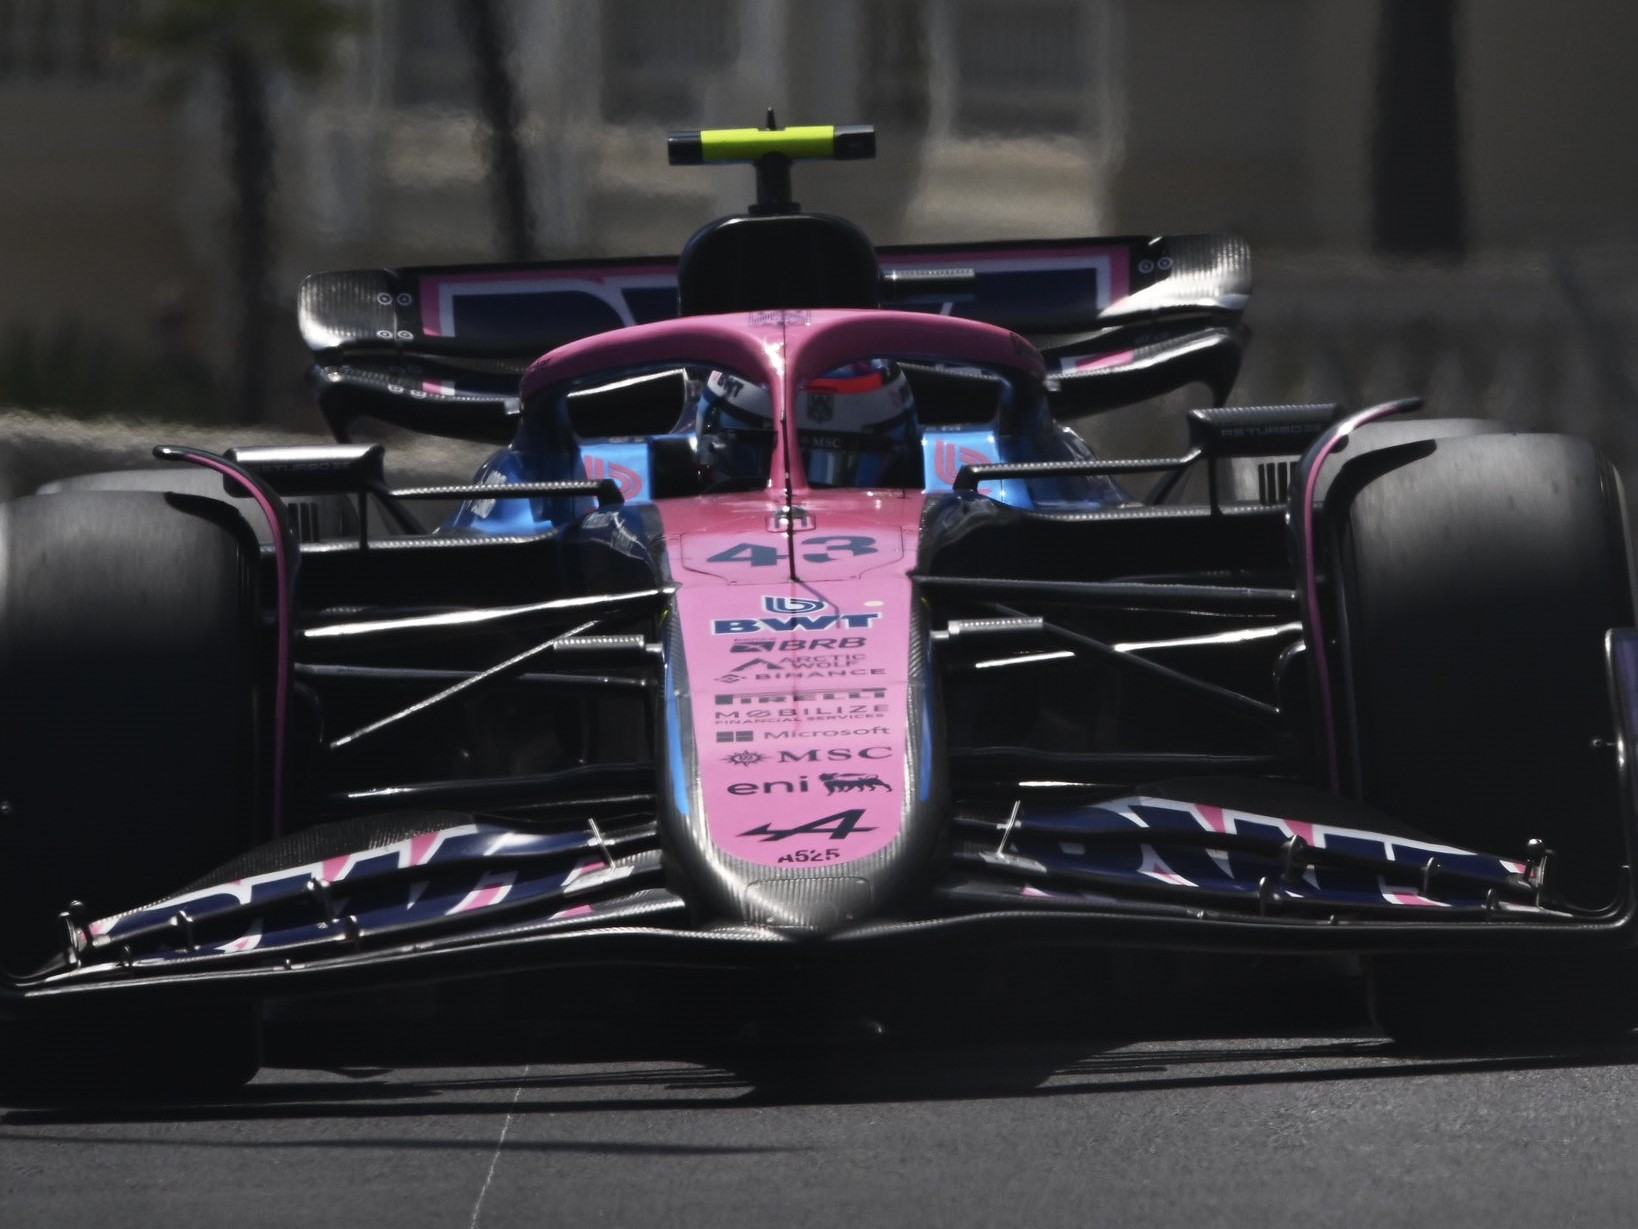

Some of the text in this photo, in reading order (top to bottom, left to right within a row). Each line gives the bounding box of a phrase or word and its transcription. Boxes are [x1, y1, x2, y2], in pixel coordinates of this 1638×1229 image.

[706, 535, 879, 567] 43
[712, 613, 880, 634] BWT
[778, 637, 867, 651] BRB
[779, 653, 866, 663] ARCTIC
[792, 660, 860, 669] WOLF
[755, 668, 886, 680] BINANCE
[764, 726, 891, 740] Microsoft
[777, 747, 892, 763] MSC
[727, 775, 809, 796] eni
[777, 848, 841, 863] A525
